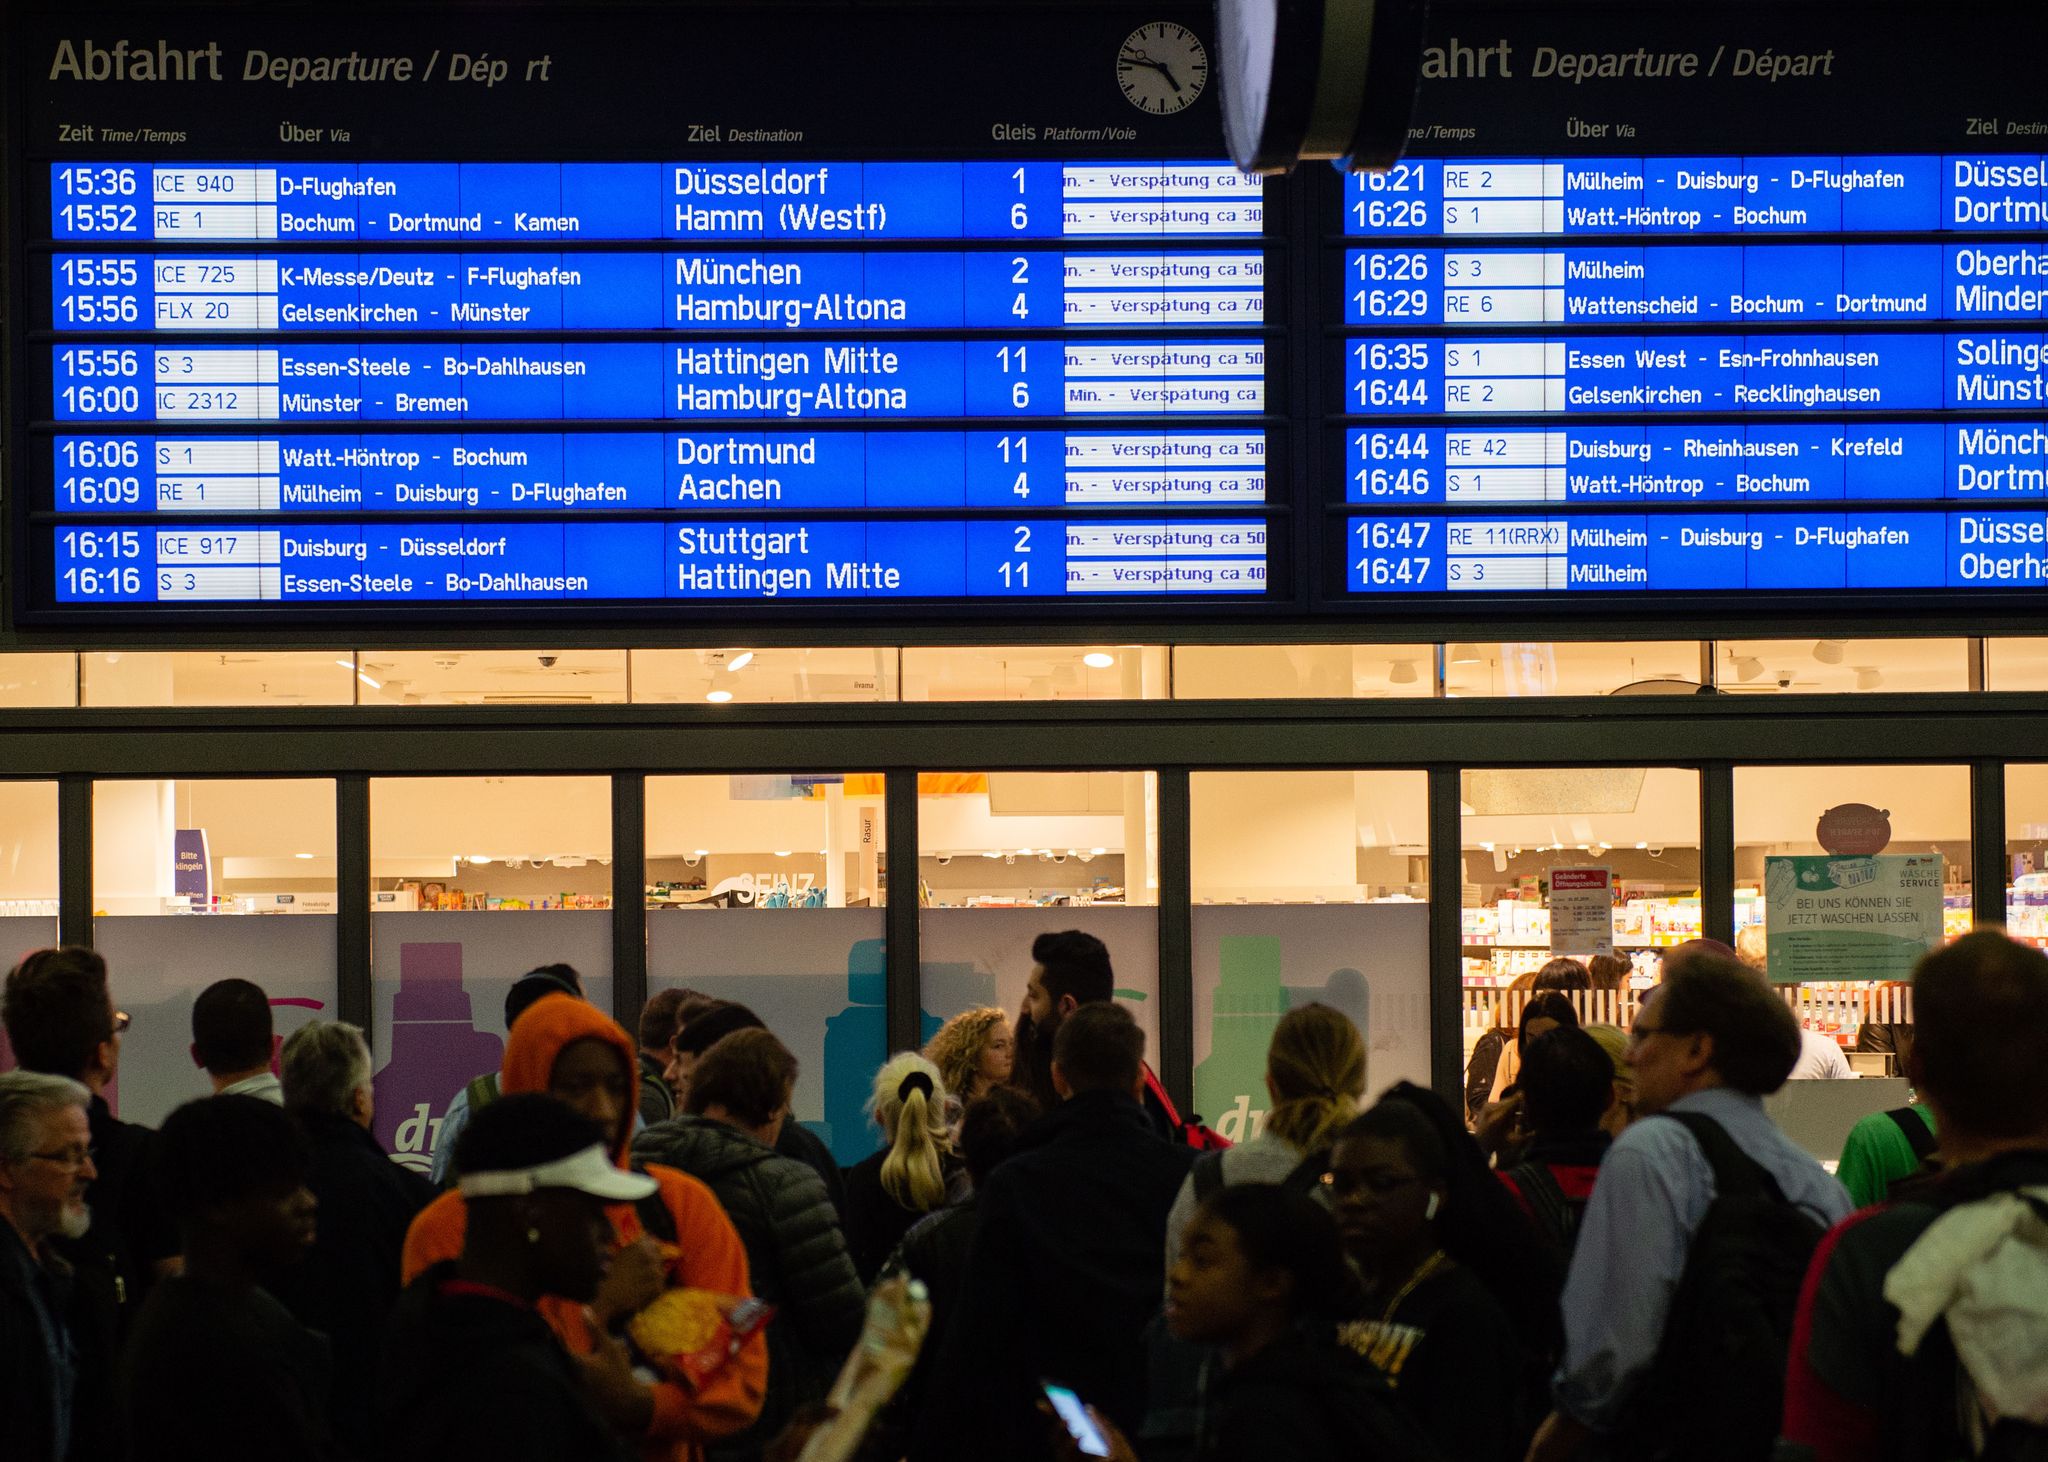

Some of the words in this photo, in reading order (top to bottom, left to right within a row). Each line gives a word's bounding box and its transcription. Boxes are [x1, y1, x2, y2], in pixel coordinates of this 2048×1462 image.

[50, 40, 222, 80] Abfahrt
[243, 51, 412, 88] Departure
[1532, 48, 1698, 84] Departure
[1733, 49, 1834, 82] Départ
[59, 125, 94, 141] Zeit
[280, 121, 323, 142] Über
[331, 129, 350, 142] Via
[688, 125, 721, 142] Ziel
[729, 129, 802, 142] Destination
[992, 124, 1036, 140] Gleis
[1567, 117, 1609, 137] Über
[1616, 125, 1635, 137] Via
[1966, 119, 1998, 134] Ziel
[59, 168, 136, 195] 15:36
[156, 174, 185, 193] ICE
[196, 175, 234, 193] 940
[280, 177, 396, 201] D-Flughafen
[675, 167, 828, 195] Düsseldorf
[1353, 164, 1424, 192] 16:21
[1446, 171, 1470, 189] RE
[1479, 170, 1492, 188] 2
[1567, 171, 1644, 191] Mülheim
[1677, 170, 1759, 194] Duisburg
[1791, 169, 1904, 193] D-Flughafen
[60, 204, 137, 232] 15:52
[280, 213, 355, 232] Bochum
[389, 212, 481, 232] Dortmund
[514, 212, 579, 232] Kamen
[675, 204, 763, 231] Hamm
[779, 203, 886, 231] (Westf)
[1352, 200, 1427, 227] 16:26
[1567, 206, 1701, 230] Watt.-Höntrop
[1733, 206, 1807, 225] Bochum
[60, 259, 138, 286] 15:55
[157, 265, 187, 283] ICE
[197, 265, 235, 284] 725
[281, 267, 434, 286] K-Messe/Deutz
[468, 266, 581, 290] F-Flughafen
[676, 258, 801, 285] München
[1353, 253, 1428, 281] 16:26
[1568, 260, 1645, 279] Mülheim
[61, 295, 138, 322] 15:56
[157, 301, 193, 320] FLX
[204, 301, 229, 320] 20
[282, 303, 418, 322] Gelsenkirchen
[451, 302, 531, 322] Münster
[676, 293, 906, 328] Hamburg-Altona
[1012, 292, 1029, 320] 4
[1245, 298, 1263, 311] 70
[1353, 289, 1428, 316] 16:29
[1446, 295, 1470, 313] RE
[1480, 295, 1493, 313] 6
[1568, 295, 1698, 315] Wattenscheid
[1730, 294, 1804, 314] Bochum
[1836, 293, 1927, 313] Dortmund
[61, 350, 138, 377] 15:56
[282, 357, 411, 376] Essen-Steele
[443, 357, 586, 376] Bo-Dahlhausen
[677, 347, 809, 381] Hattingen
[824, 347, 898, 374] Mitte
[996, 346, 1026, 373] 11
[1354, 343, 1429, 370] 16:35
[1568, 350, 1625, 369] Essen
[1635, 349, 1687, 368] West
[1719, 348, 1879, 368] Esn-Frohnhausen
[62, 385, 139, 413] 16:00
[158, 392, 176, 410] IC
[187, 392, 238, 410] 2312
[282, 393, 363, 412] Münster
[396, 393, 468, 412] Bremen
[677, 382, 907, 417] Hamburg-Altona
[1069, 389, 1102, 402] Min.
[1236, 389, 1257, 401] ca
[1353, 379, 1428, 406] 16:44
[1568, 385, 1702, 404] Gelsenkirchen
[1734, 384, 1881, 407] Recklinghausen
[62, 440, 139, 468] 16:06
[158, 447, 171, 465] S
[184, 447, 192, 465] 1
[283, 448, 420, 471] Watt.-Höntrop
[453, 447, 528, 466] Bochum
[677, 437, 815, 465] Dortmund
[996, 436, 1027, 463] 11
[1354, 433, 1429, 460] 16:44
[1447, 439, 1472, 456] RE
[1482, 438, 1507, 456] 42
[1569, 439, 1651, 463] Duisburg
[1684, 438, 1799, 457] Rheinhausen
[1831, 437, 1903, 456] Krefeld
[63, 477, 140, 504] 16:09
[283, 484, 362, 503] Mülheim
[395, 483, 479, 506] Duisburg
[511, 482, 627, 506] D-Flughafen
[678, 473, 781, 500] Aachen
[1354, 468, 1429, 495] 16:46
[1569, 474, 1704, 497] Watt.-Höntrop
[1736, 473, 1810, 493] Bochum
[63, 531, 140, 558] 16:15
[156, 537, 189, 555] ICE
[200, 537, 238, 555] 917
[283, 538, 367, 561] Duisburg
[400, 537, 506, 557] Düsseldorf
[678, 527, 809, 561] Stuttgart
[1356, 522, 1431, 549] 16:47
[1448, 527, 1473, 545] RE
[1484, 526, 1560, 547] 11(RRX)
[1571, 528, 1648, 547] Mülheim
[1681, 527, 1763, 550] Duisburg
[1795, 526, 1909, 549] D-Flughafen
[63, 567, 140, 594] 16:16
[284, 574, 413, 593] Essen-Steele
[446, 572, 588, 592] Bo-Dahlhausen
[679, 563, 811, 597] Hattingen
[826, 562, 900, 589] Mitte
[998, 561, 1028, 588] 11
[1246, 567, 1266, 580] 40
[1355, 557, 1431, 584] 16:47
[1448, 563, 1462, 581] S
[1471, 563, 1484, 581] 3
[1570, 564, 1647, 583] Mülheim
[863, 819, 872, 843] Rasur
[175, 862, 203, 872] klingeln
[180, 851, 198, 860] Bitte
[1554, 872, 1587, 880] Geänderte
[1900, 879, 1940, 888] SERVICE
[1796, 898, 1815, 909] BEI
[1818, 898, 1841, 909] UNS
[1845, 895, 1892, 908] KÖNNEN
[1895, 896, 1913, 908] SIE
[1787, 914, 1818, 925] JETZT
[1820, 912, 1874, 924] WASCHEN
